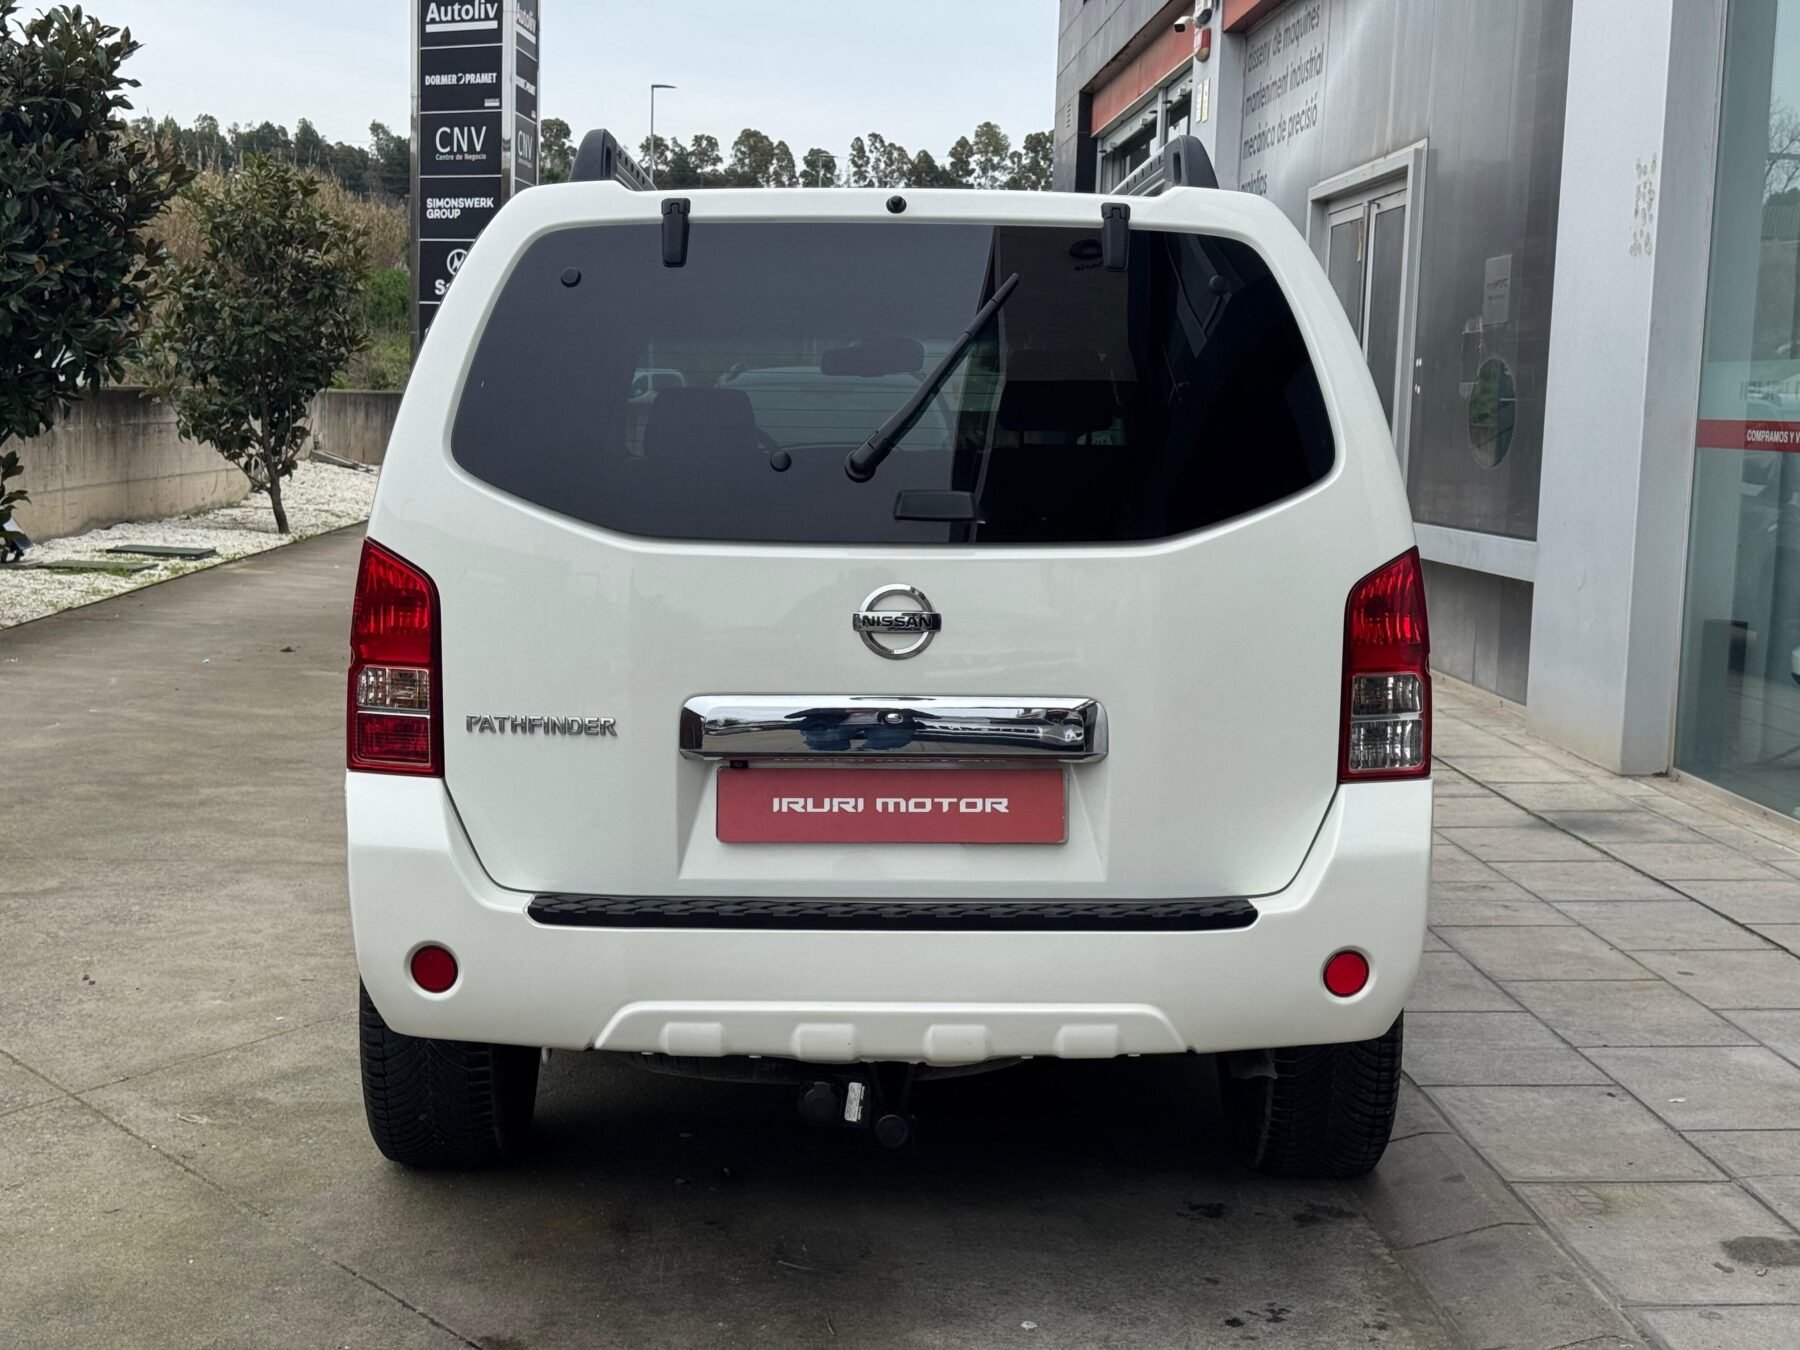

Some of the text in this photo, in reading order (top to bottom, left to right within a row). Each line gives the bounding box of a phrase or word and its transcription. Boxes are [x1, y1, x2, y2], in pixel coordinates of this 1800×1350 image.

[425, 0, 498, 22] Autoliv
[1289, 42, 1325, 92] industrial
[425, 72, 497, 86] DORMER PRAMET
[1276, 113, 1287, 144] de
[435, 126, 487, 153] CNV
[455, 153, 463, 161] de
[426, 197, 494, 209] SIMONSWERK
[426, 208, 461, 219] GROUP
[1746, 429, 1789, 443] COMPRAMOS
[1790, 431, 1795, 443] Y
[862, 615, 932, 627] NISSAN
[465, 714, 618, 737] PATHFINDER
[773, 797, 1010, 813] IRURI MOTOR
